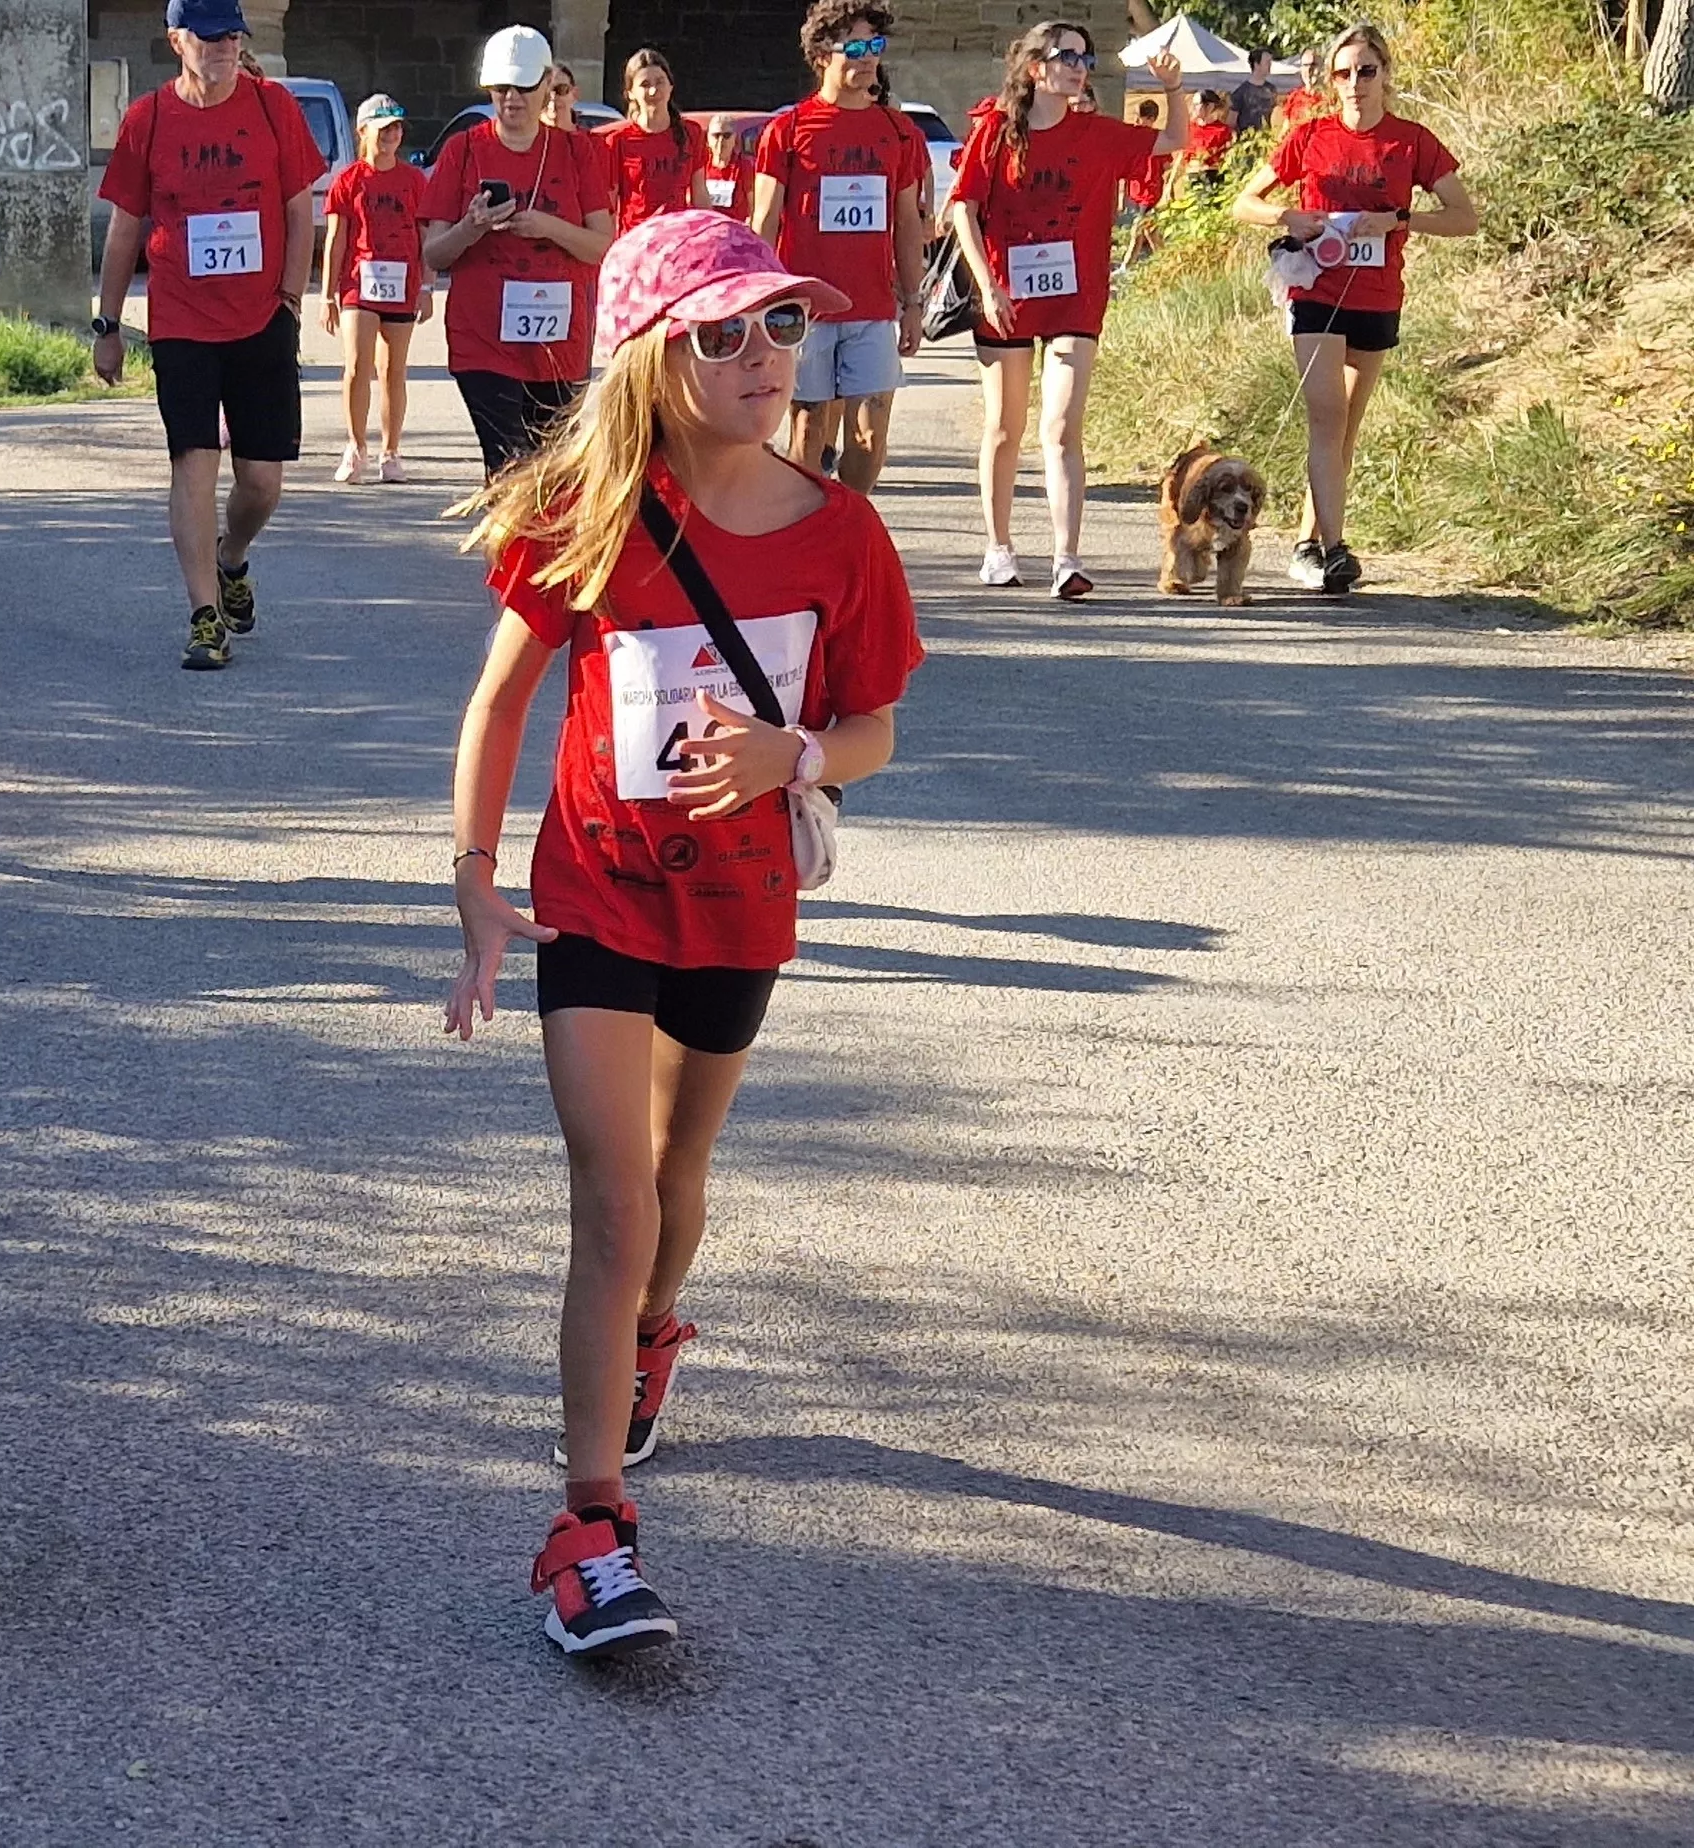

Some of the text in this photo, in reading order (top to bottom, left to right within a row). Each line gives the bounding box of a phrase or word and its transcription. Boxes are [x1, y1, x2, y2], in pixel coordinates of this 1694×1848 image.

[833, 205, 873, 226] 401
[204, 246, 246, 270] 371
[369, 282, 396, 298] 453
[1024, 271, 1064, 293] 188
[517, 315, 558, 337] 372
